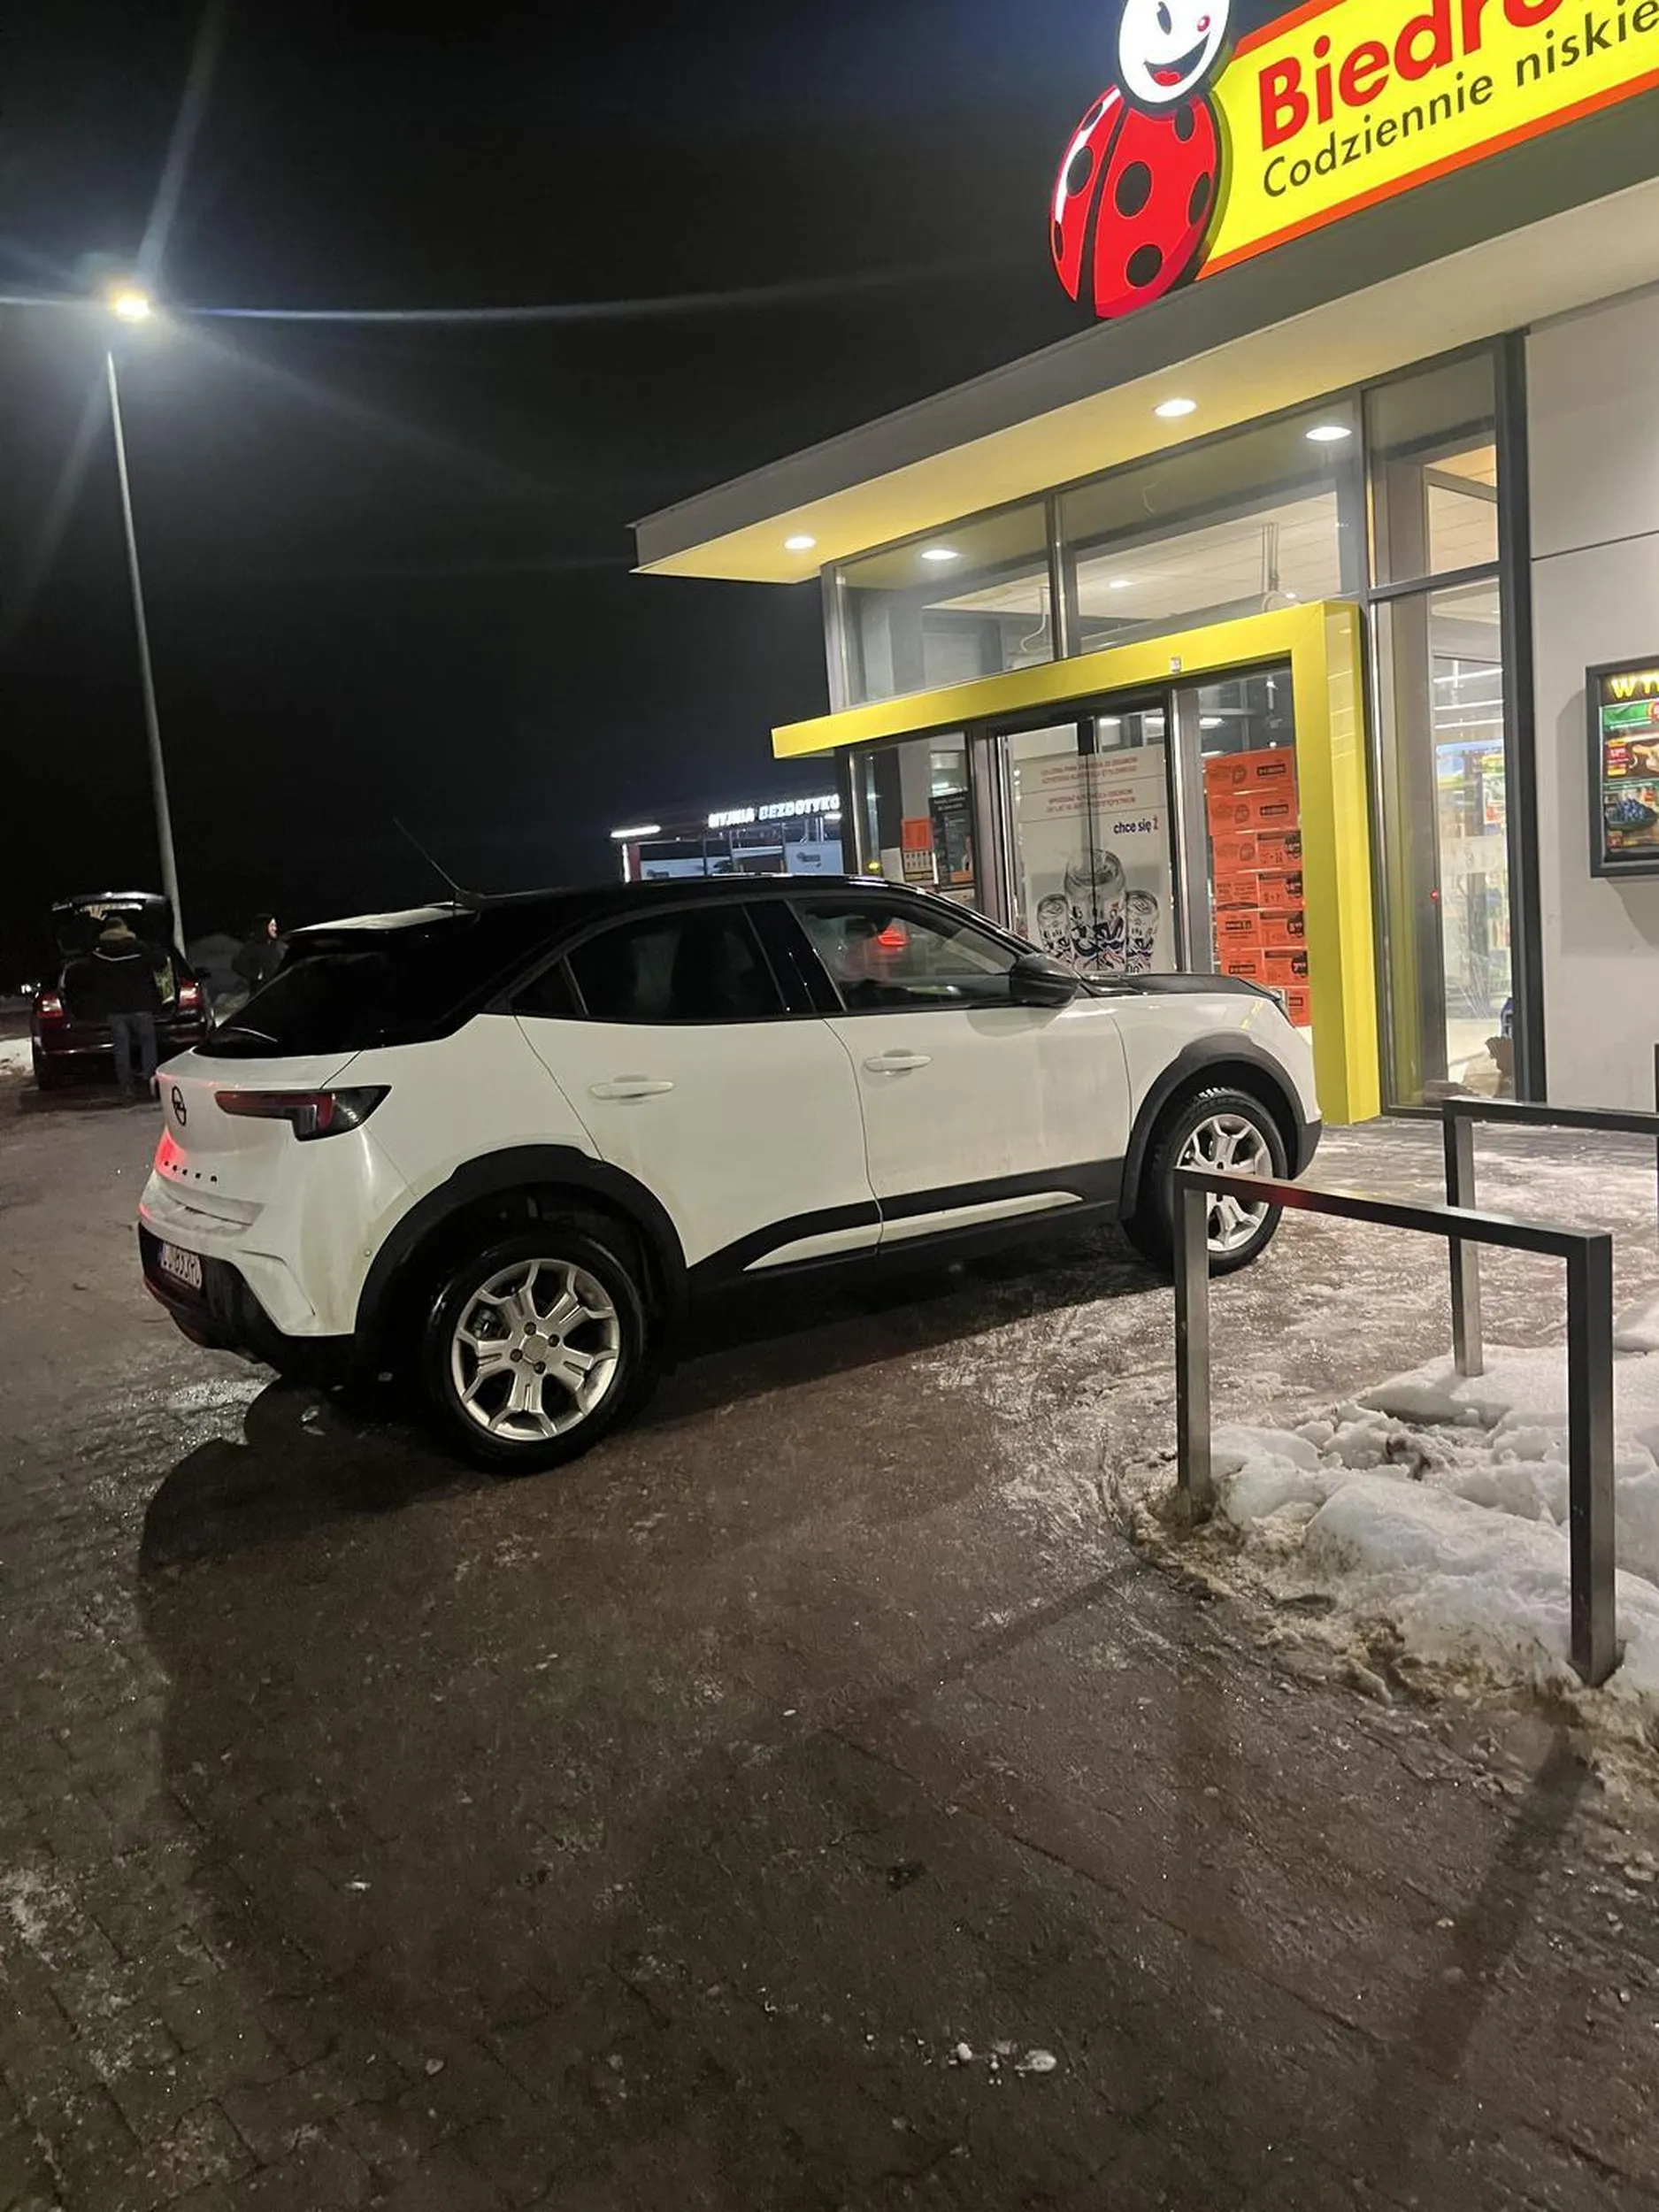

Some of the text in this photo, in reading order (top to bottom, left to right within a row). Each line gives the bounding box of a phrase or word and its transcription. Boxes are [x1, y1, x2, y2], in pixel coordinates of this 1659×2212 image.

[1263, 0, 1659, 197] Codziennie niskie
[1113, 821, 1136, 834] chce
